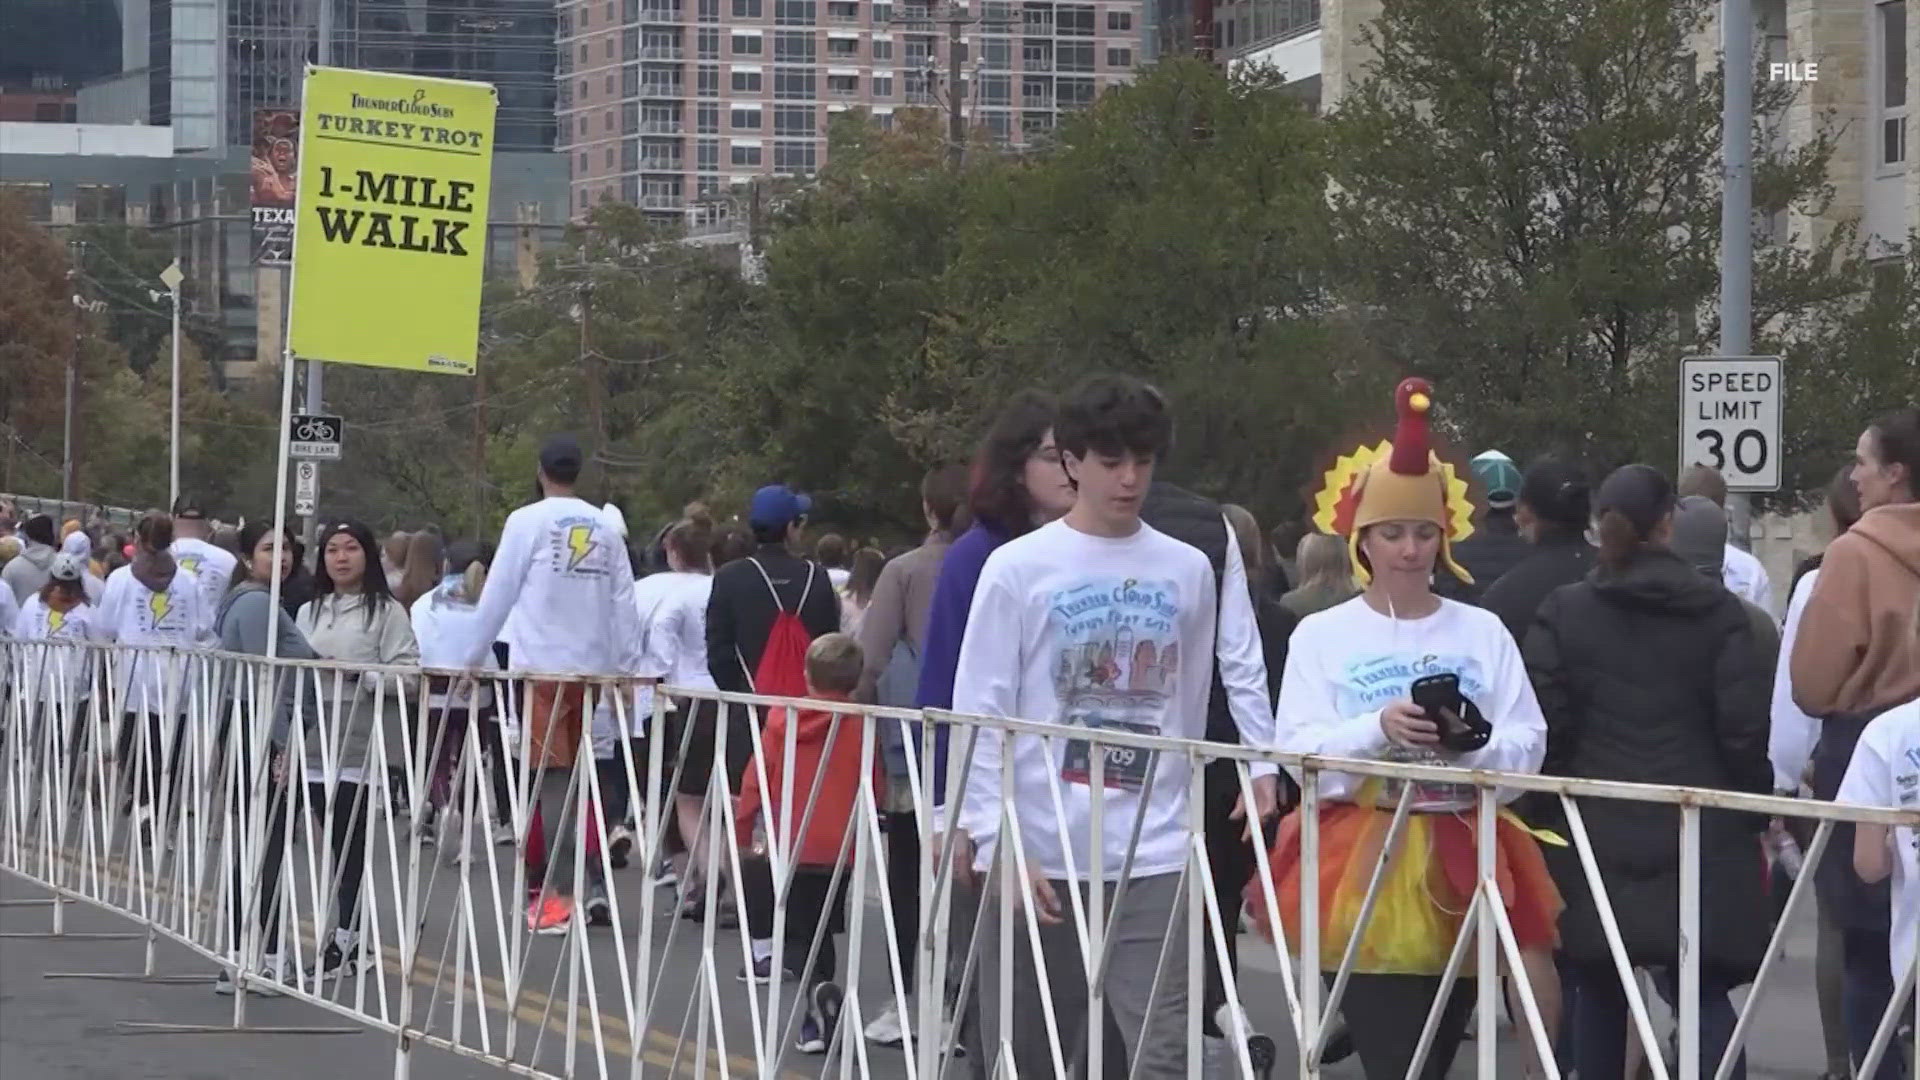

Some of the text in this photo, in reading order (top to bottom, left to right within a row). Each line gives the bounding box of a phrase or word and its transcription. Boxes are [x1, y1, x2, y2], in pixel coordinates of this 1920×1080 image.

[317, 113, 483, 148] TURKEY TROT
[319, 166, 475, 213] 1-MILE
[252, 206, 295, 225] TEXA
[316, 206, 470, 256] WALK
[1692, 373, 1772, 392] SPEED
[1699, 401, 1762, 420] LIMIT
[294, 444, 335, 455] BIKE LANE
[1695, 428, 1768, 474] 30
